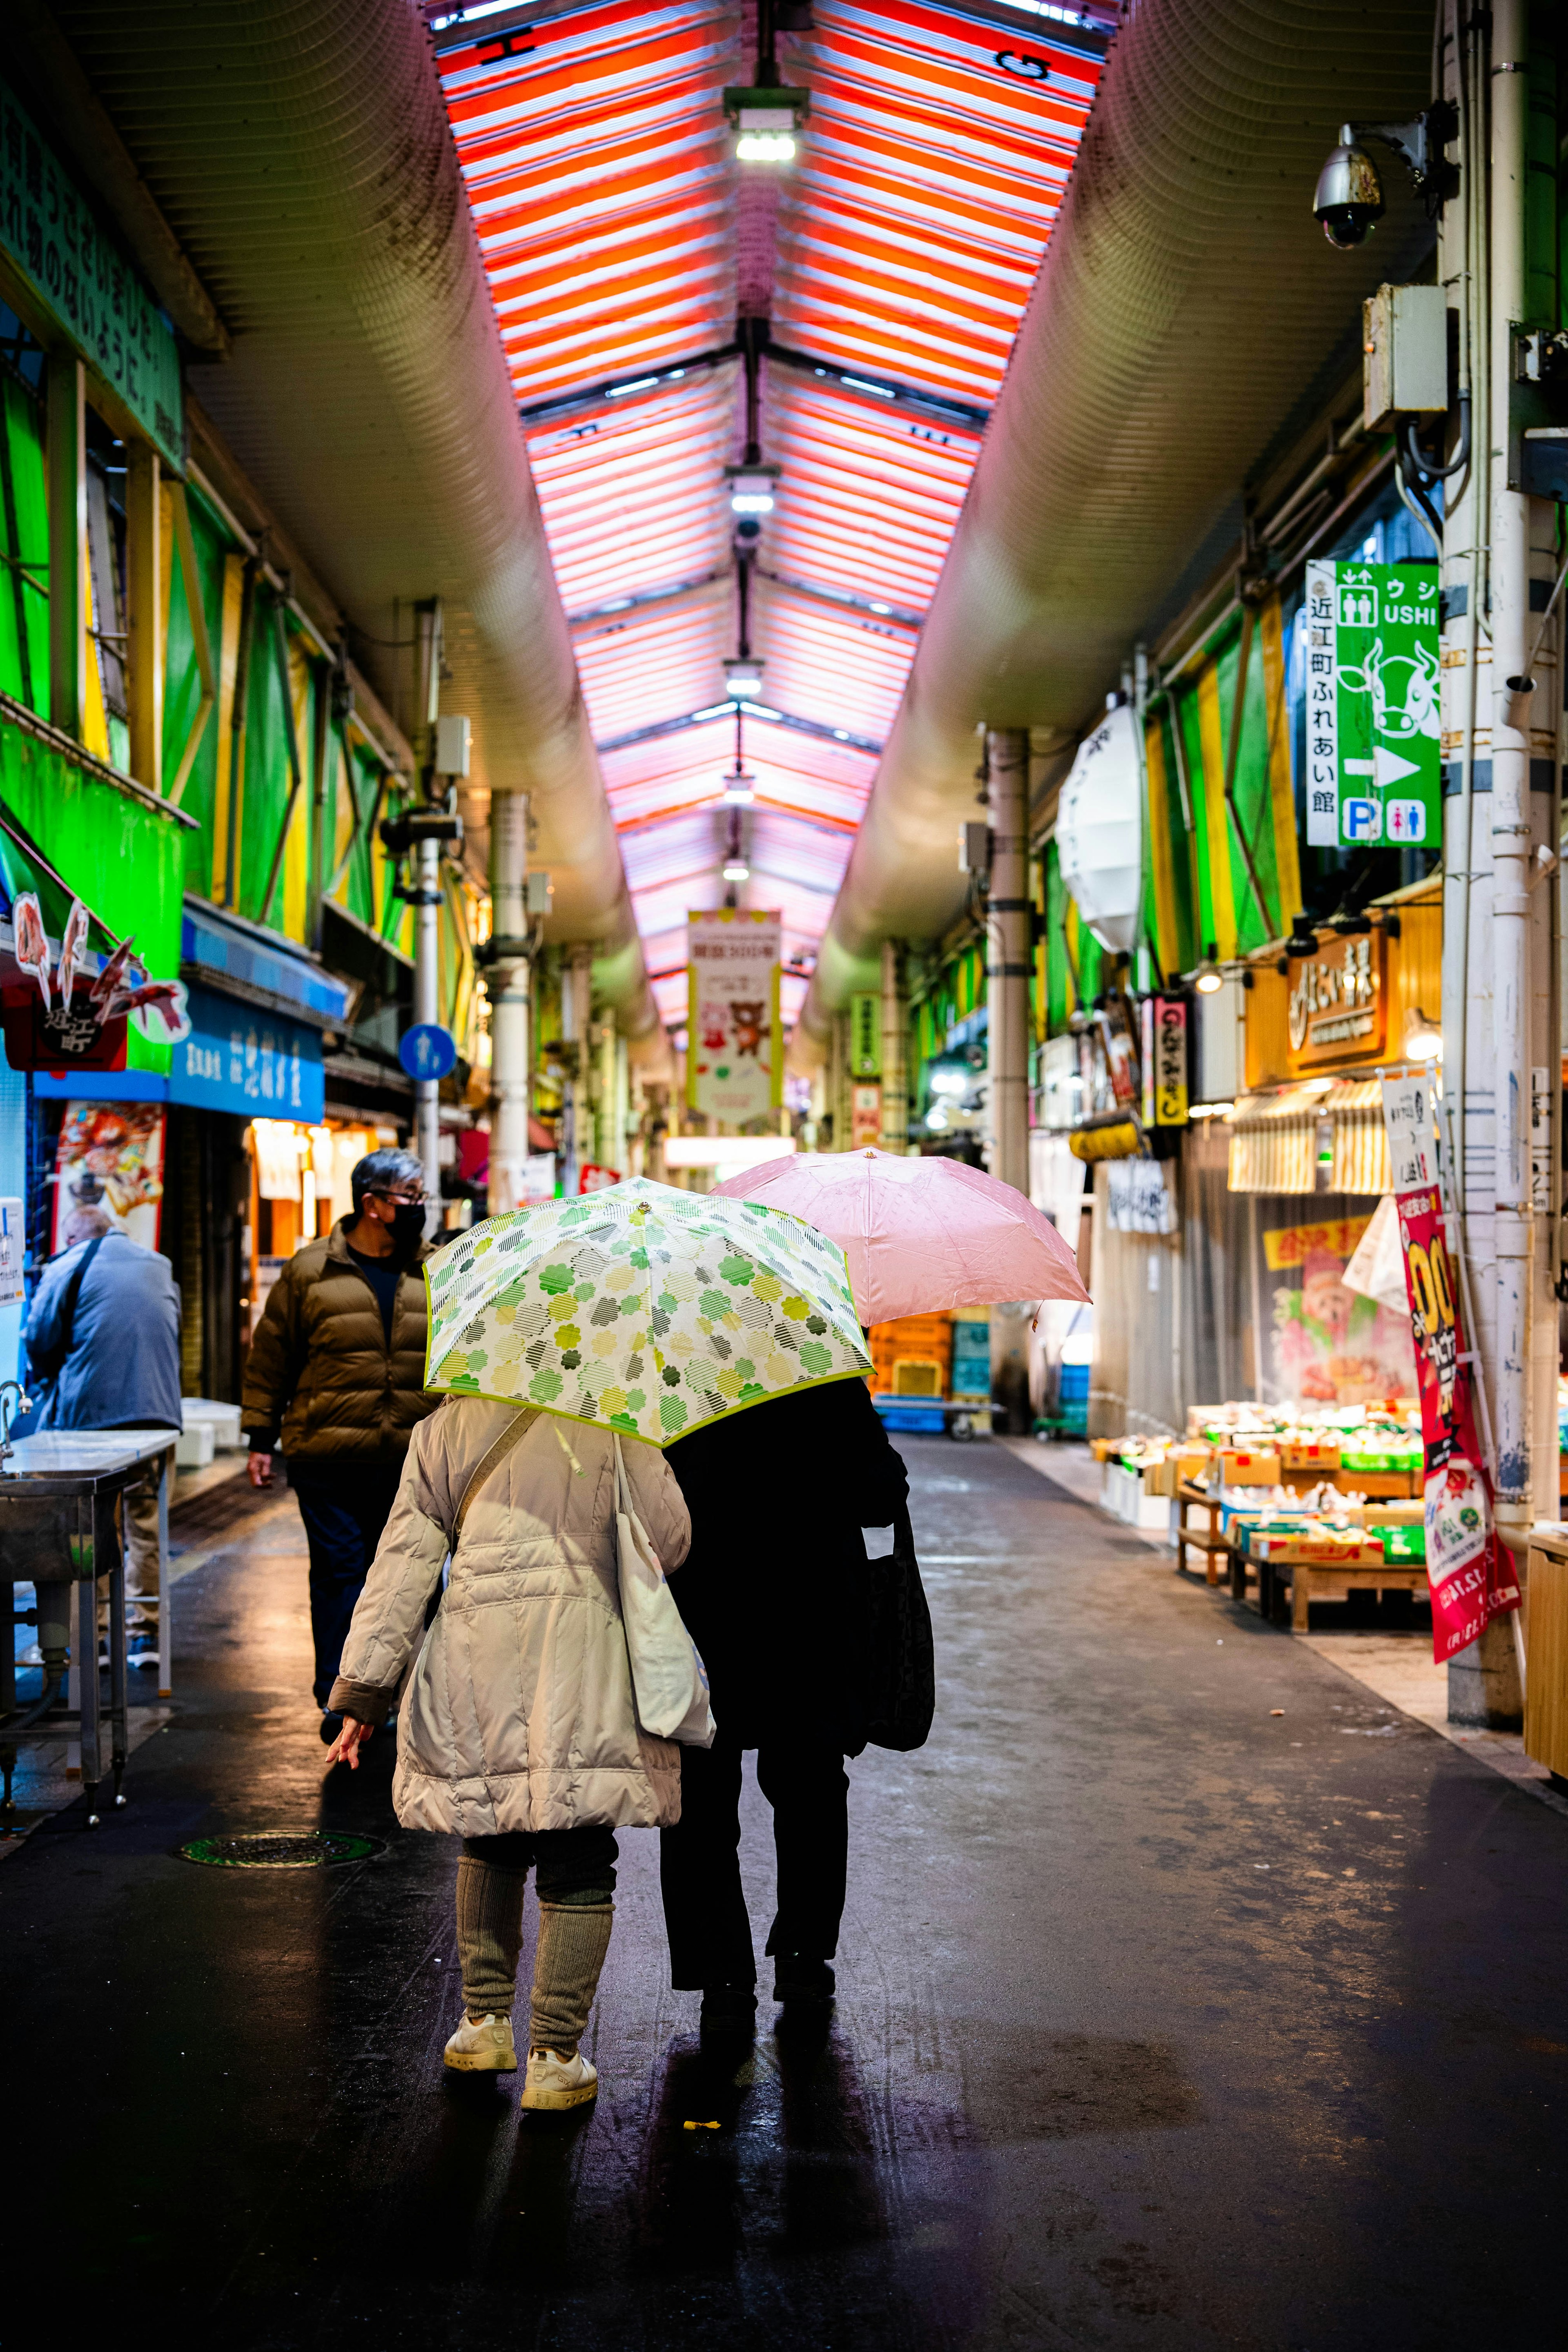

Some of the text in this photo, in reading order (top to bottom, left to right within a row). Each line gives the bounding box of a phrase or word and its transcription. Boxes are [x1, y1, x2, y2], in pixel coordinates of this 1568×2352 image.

[476, 26, 535, 65] H
[1387, 579, 1436, 600] ウシ
[1384, 605, 1437, 626] USHI
[1310, 598, 1334, 813] 近江町ふれあい館
[1349, 801, 1376, 837] P
[558, 2075, 570, 2088] GTX
